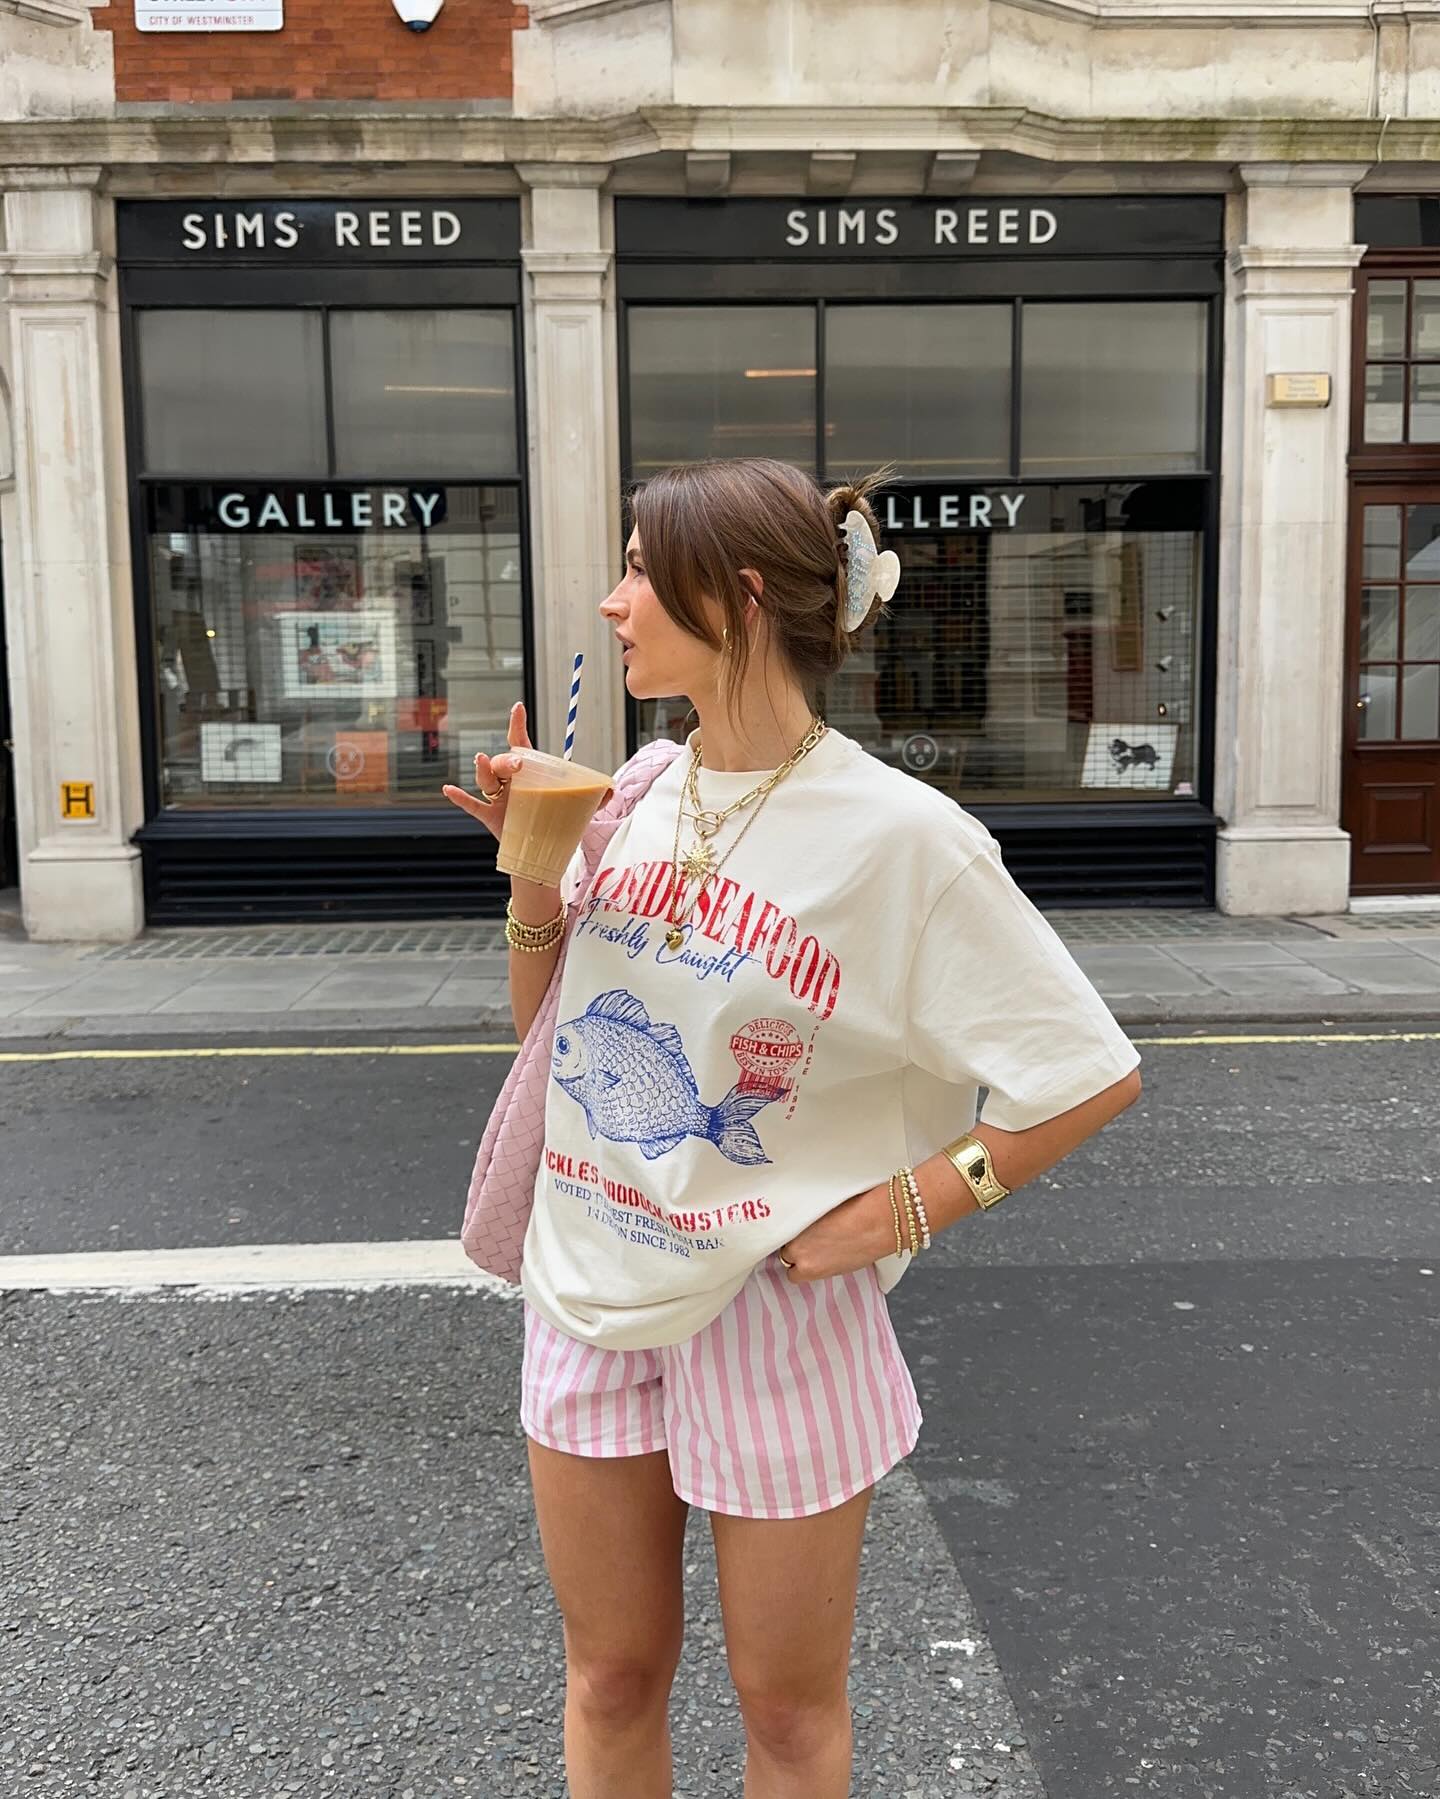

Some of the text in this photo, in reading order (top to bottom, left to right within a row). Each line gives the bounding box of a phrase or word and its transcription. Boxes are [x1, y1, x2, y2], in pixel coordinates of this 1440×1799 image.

[149, 16, 255, 25] CITY OF WESTMINSTER
[182, 211, 462, 250] SIMS REED
[785, 209, 1058, 246] SIMS REED
[217, 493, 440, 528] GALLERY
[886, 494, 1026, 529] LLERY
[731, 1036, 802, 1057] FISH & CHIPS
[737, 1051, 755, 1070] BEST
[554, 1178, 592, 1201] VOTED
[630, 1230, 667, 1251] SINCE
